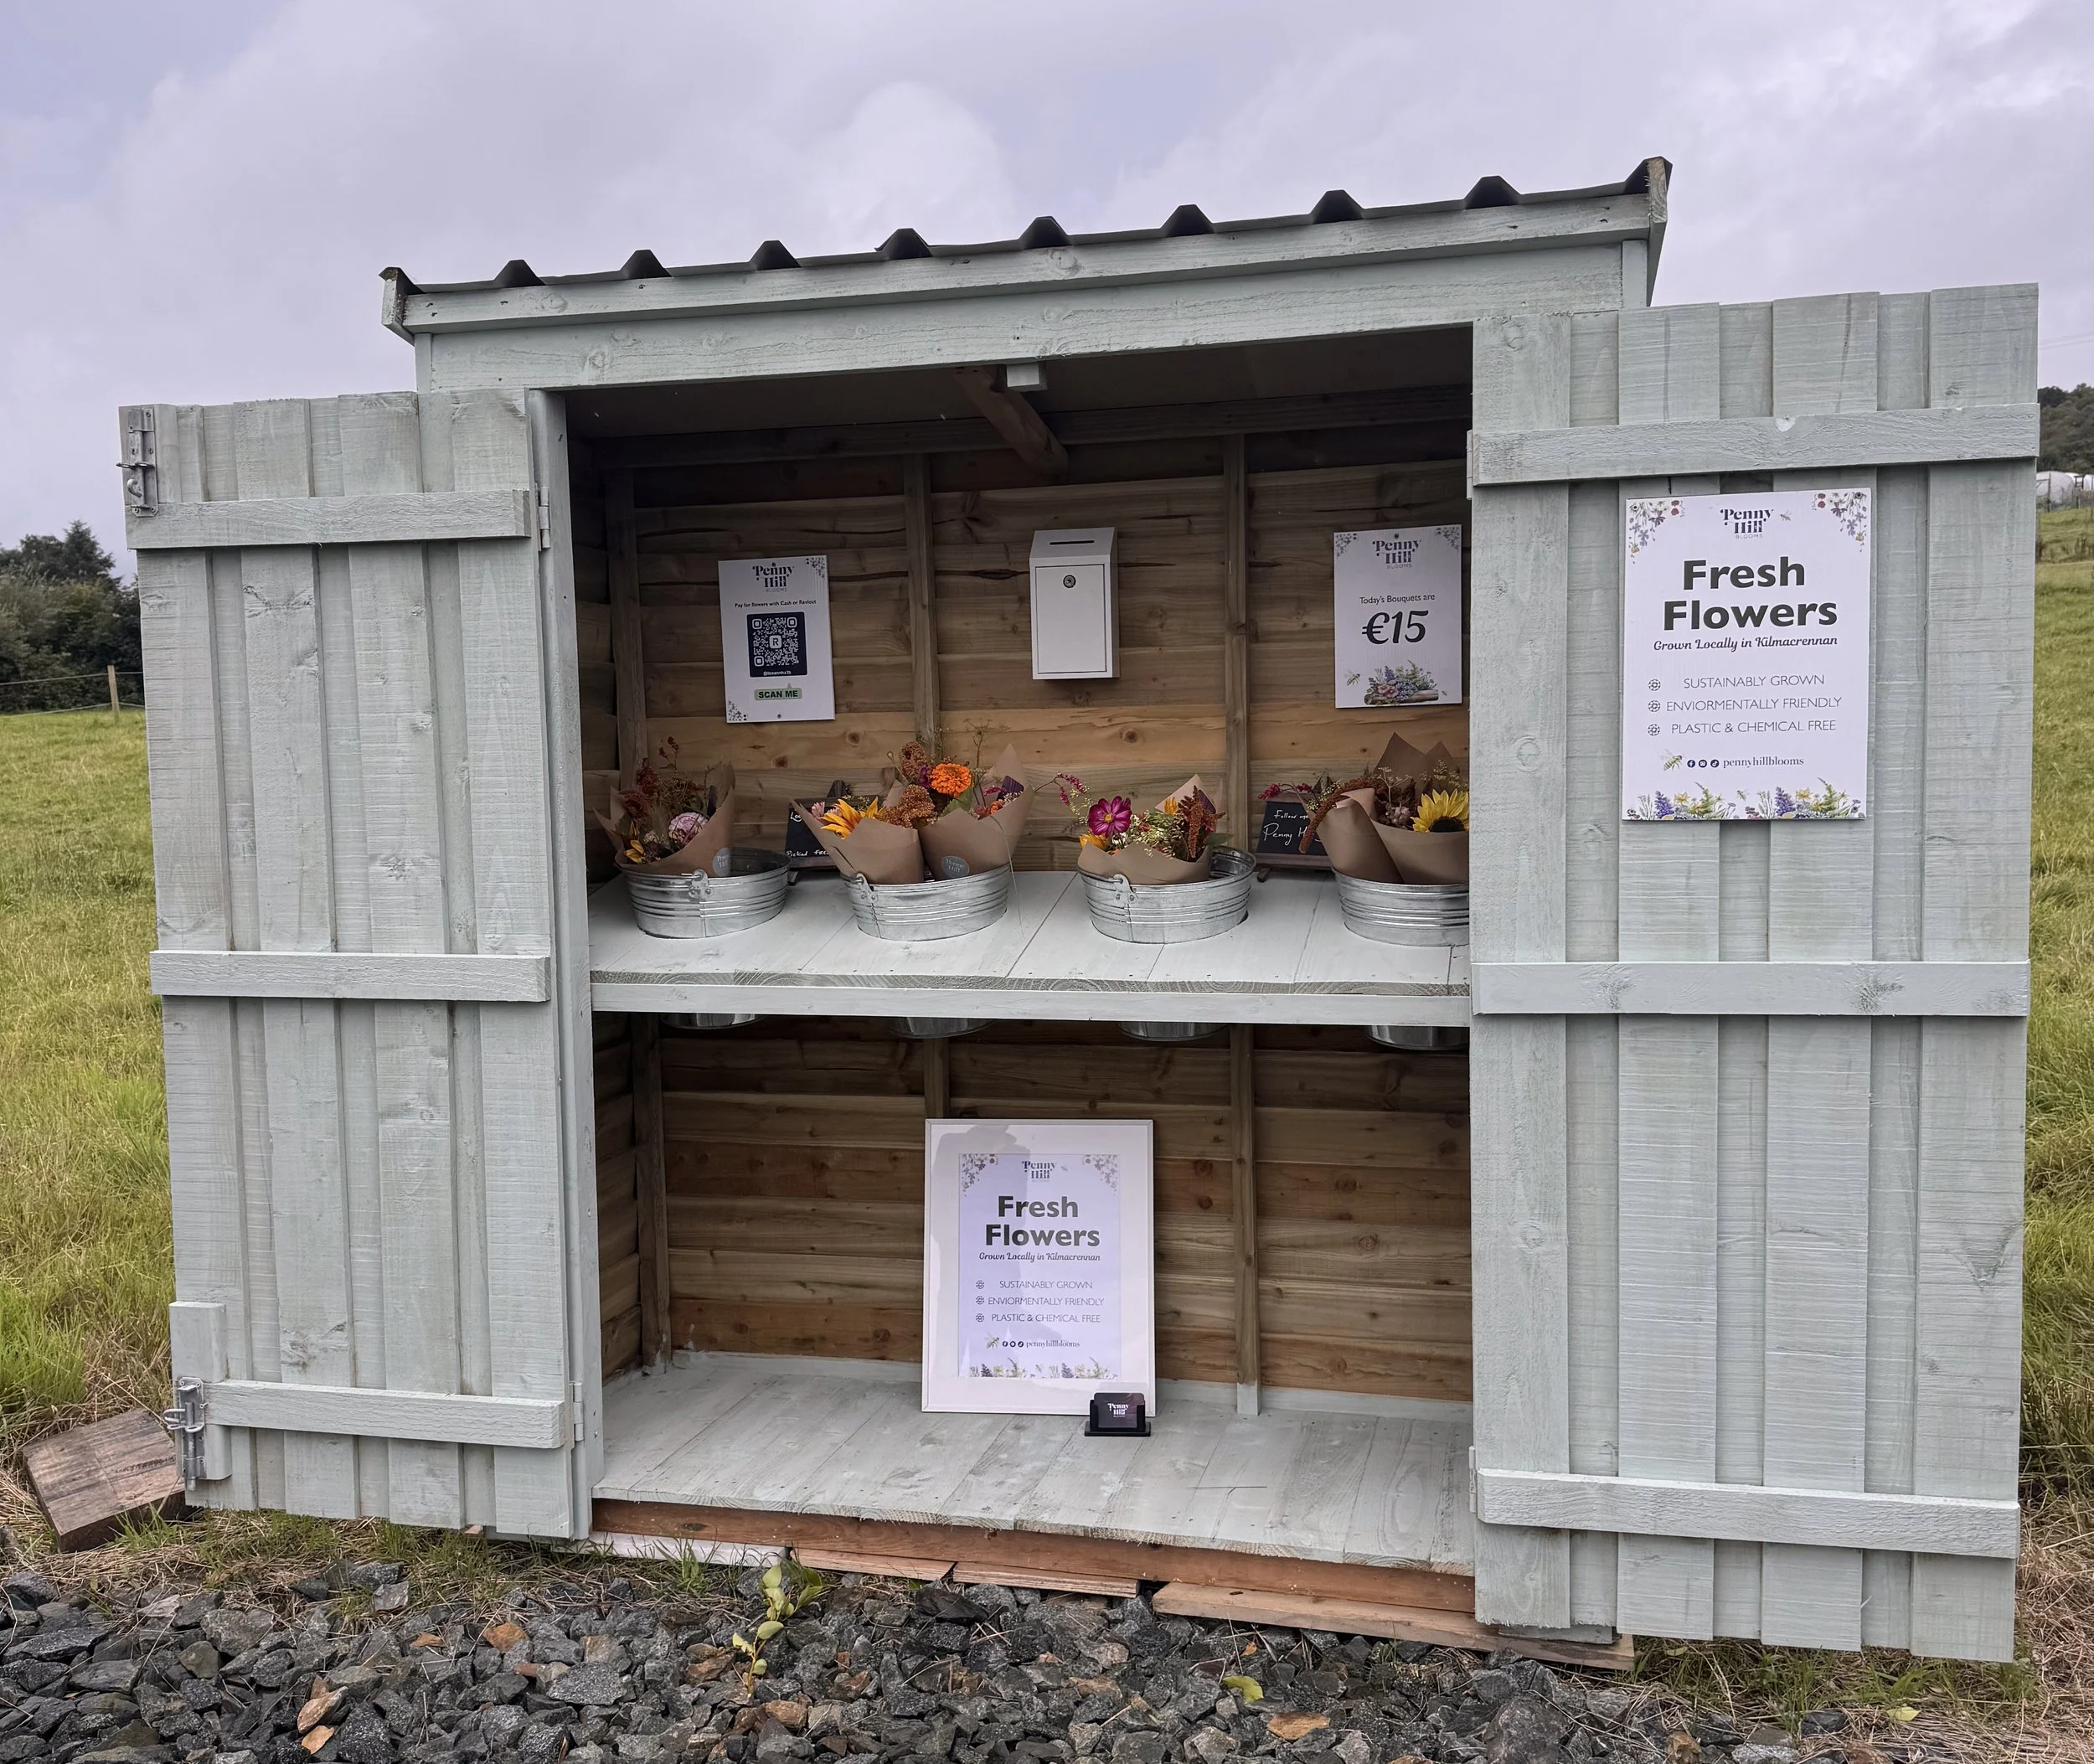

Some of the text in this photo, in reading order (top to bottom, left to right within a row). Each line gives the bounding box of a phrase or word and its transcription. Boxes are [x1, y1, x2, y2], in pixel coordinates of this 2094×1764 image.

[1720, 508, 1774, 522] Penny
[1724, 520, 1762, 534] Hill
[1372, 540, 1421, 552] Penny
[1376, 550, 1412, 565] Hill
[752, 565, 794, 578] Penny
[1683, 556, 1806, 591] Fresh
[756, 575, 787, 588] Hill
[1359, 596, 1385, 605] Today's
[1386, 595, 1421, 603] Bouquets
[1663, 600, 1838, 632] Flowers
[1361, 610, 1429, 645] €15
[1653, 636, 1839, 652] Grown Locally in Kilmacrennan
[1684, 674, 1825, 689] SUSTAINABLY GROWN
[758, 690, 783, 699] SCAN
[1666, 696, 1843, 712] ENVIORMENTALLY FRIENDLY
[1671, 720, 1837, 735] PLASTIC & CHEMICAL FREE
[1722, 756, 1805, 769] pennyhillblooms
[1274, 809, 1297, 819] Follow
[1263, 823, 1292, 846] Penny
[1022, 1161, 1056, 1171] Penny
[1024, 1169, 1050, 1179] Hill
[998, 1195, 1079, 1218] Fresh
[985, 1224, 1101, 1247] Flowers
[978, 1251, 1101, 1263] Grown Locally in Kilmacrennan
[999, 1280, 1093, 1289] SUSTAINABLY GROWN
[988, 1297, 1105, 1306] ENVIORMENTALLY FRIENDLY
[991, 1313, 1101, 1323] PLASTIC & CHEMICAL FREE
[1026, 1339, 1081, 1349] pennyhillblooms
